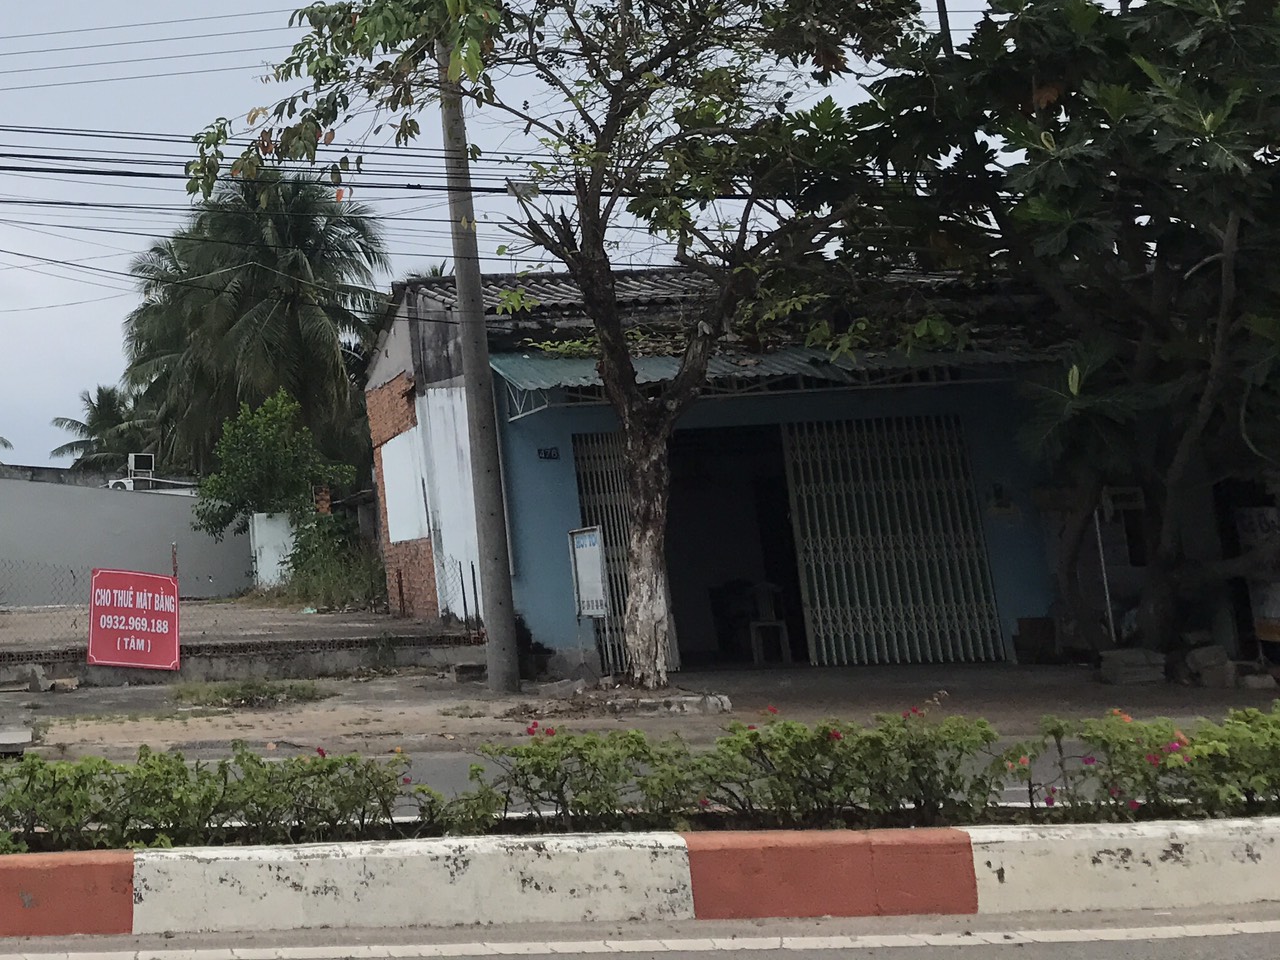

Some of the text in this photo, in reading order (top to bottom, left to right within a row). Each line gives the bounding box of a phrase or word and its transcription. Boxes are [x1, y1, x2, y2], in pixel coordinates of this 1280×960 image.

[95, 585, 175, 614] CHO THUÊ MẶT BẰNG
[100, 614, 169, 634] 0932.969.188
